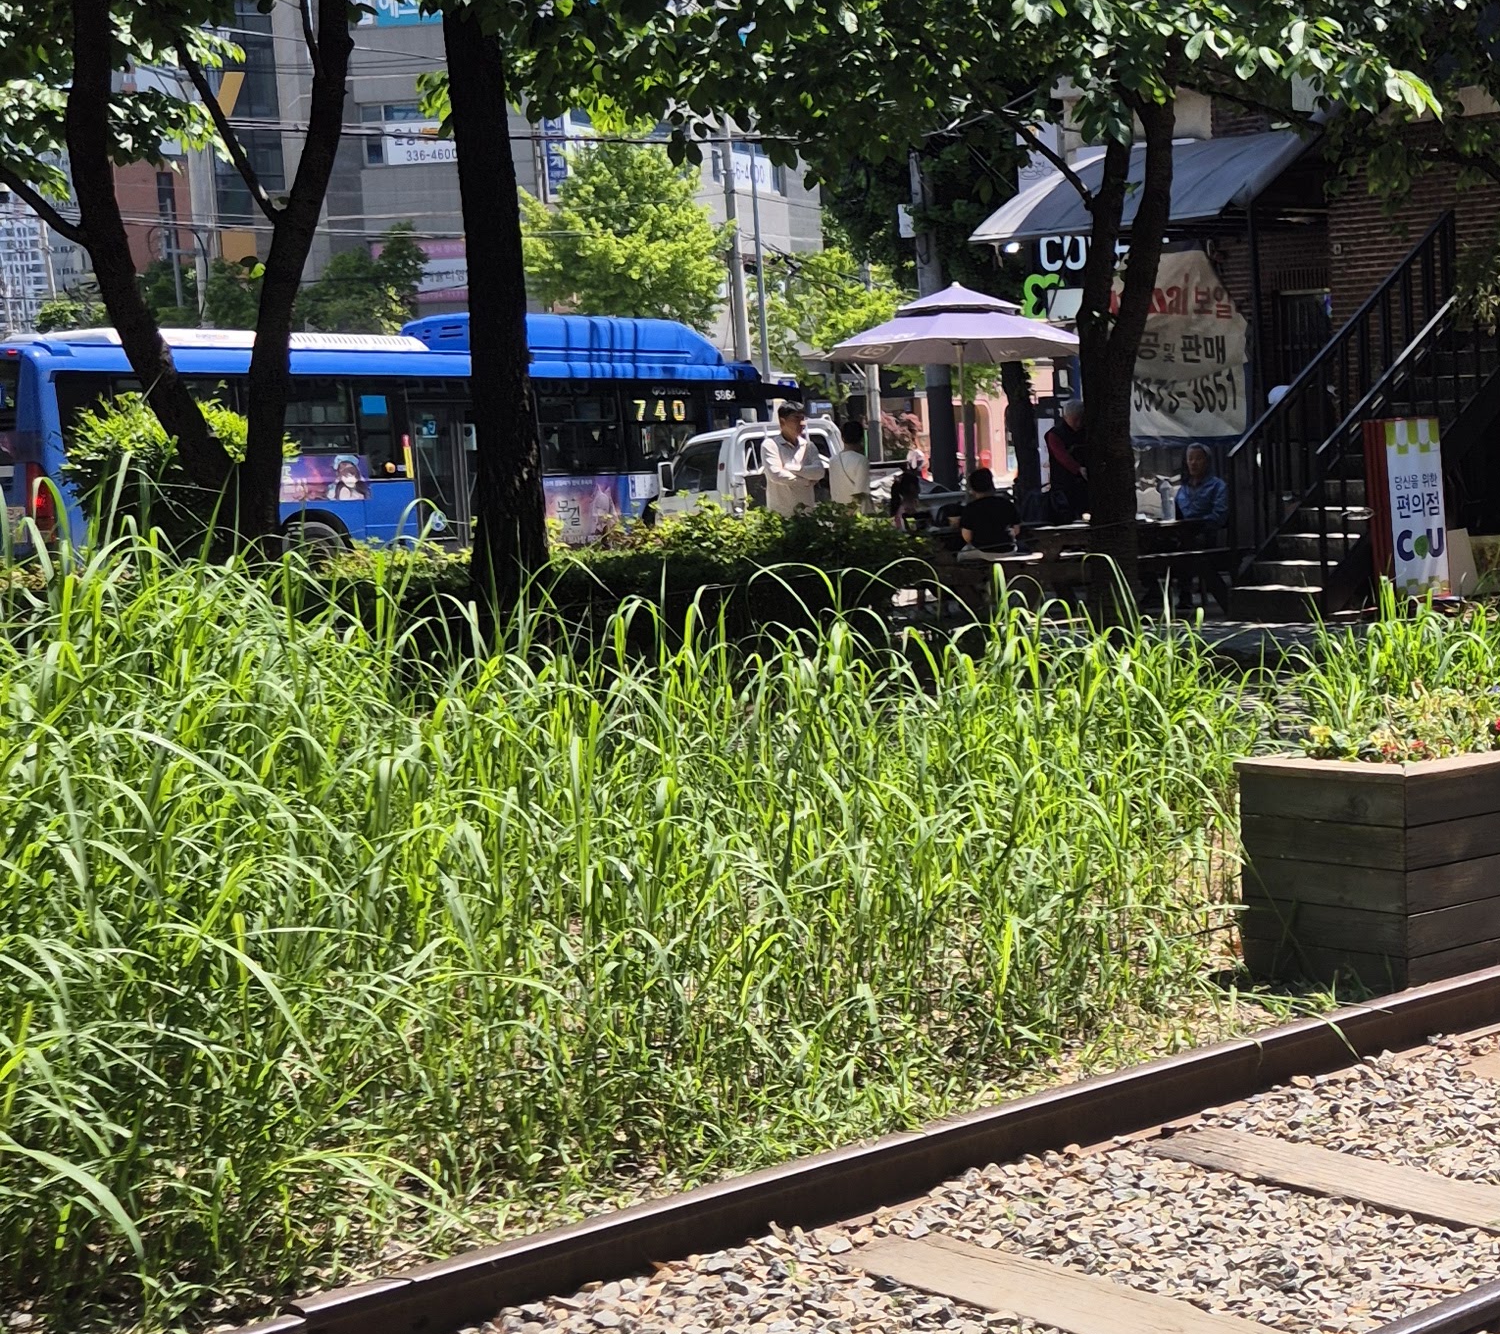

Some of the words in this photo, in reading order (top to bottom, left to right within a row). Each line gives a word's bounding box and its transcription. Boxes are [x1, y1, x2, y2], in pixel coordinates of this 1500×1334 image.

[1180, 333, 1227, 365] 판매
[632, 399, 686, 422] 740
[1394, 473, 1419, 491] 당신을
[1421, 471, 1438, 488] 위한
[1396, 490, 1441, 520] 편의점
[1396, 527, 1445, 562] CU
